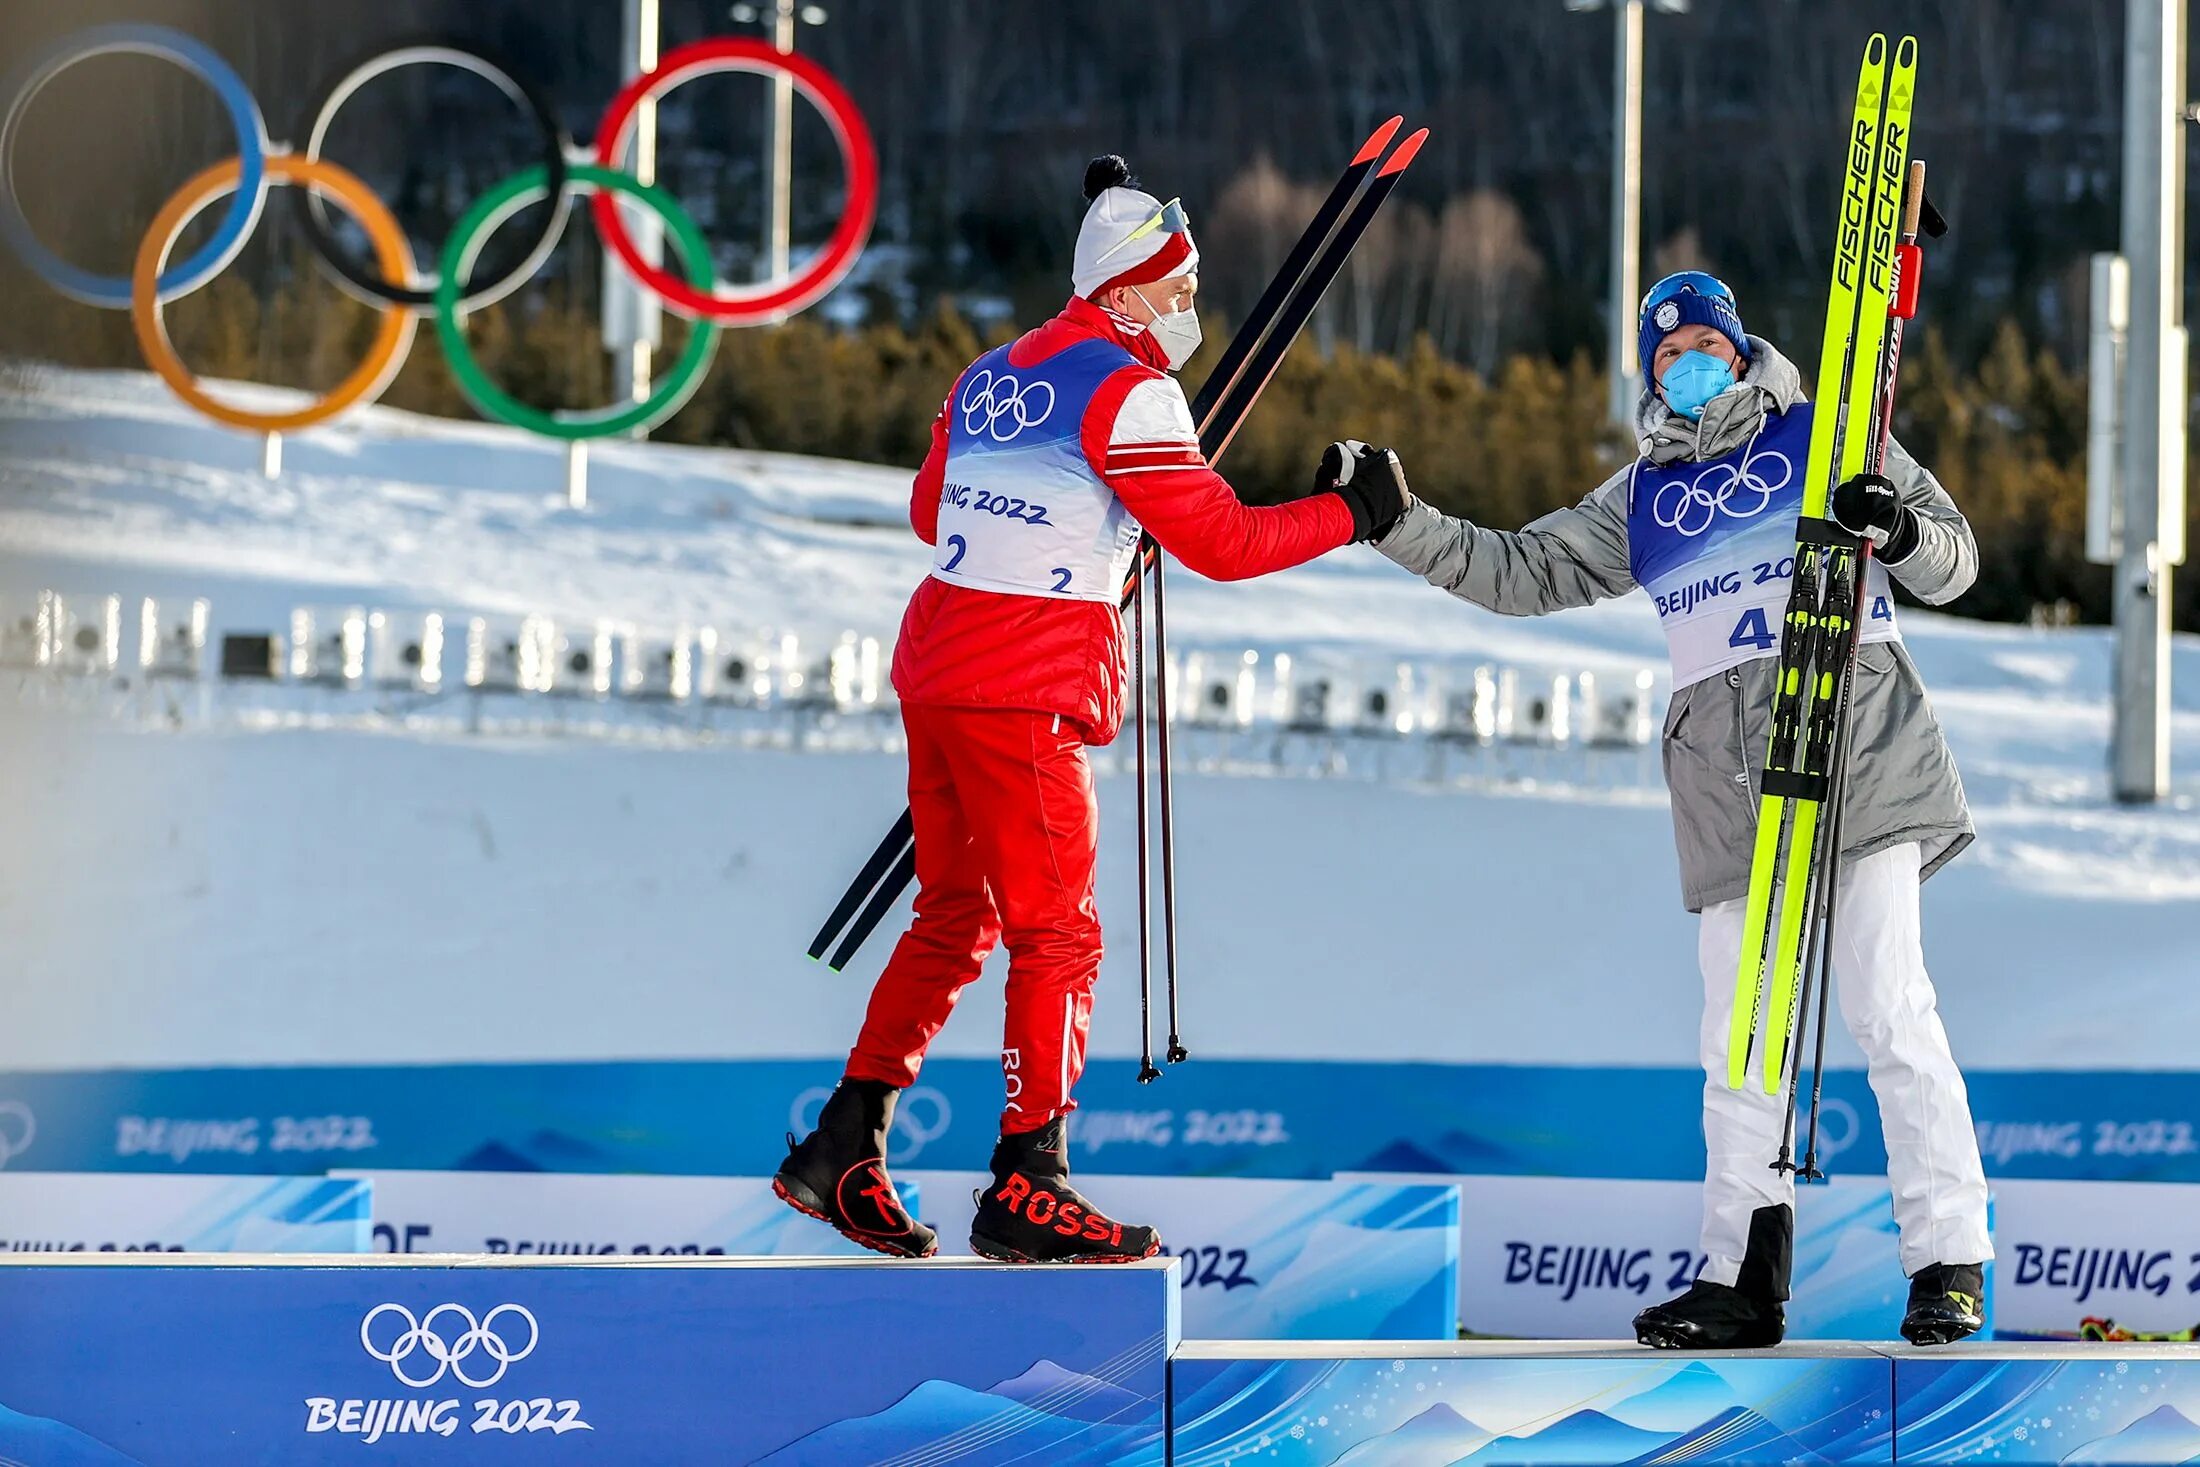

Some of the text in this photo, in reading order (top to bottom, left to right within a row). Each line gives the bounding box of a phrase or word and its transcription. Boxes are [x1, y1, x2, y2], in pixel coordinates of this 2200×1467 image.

[1837, 119, 1873, 292] FISCHER
[1870, 122, 1905, 295] FISCHER
[940, 483, 1055, 528] JING 2022
[940, 534, 967, 575] 2
[1050, 567, 1073, 594] 2
[1655, 571, 1741, 618] BEIJING
[1728, 607, 1777, 650] 4
[1871, 596, 1892, 622] 4
[116, 1115, 378, 1163] BEIJING 2022
[1183, 1109, 1290, 1146] 2022
[1975, 1119, 2199, 1166] EIJING 2022
[996, 1172, 1123, 1248] ROSSI
[1160, 1244, 1259, 1292] 022
[1504, 1241, 1652, 1303] BEIJING
[2013, 1243, 2172, 1304] BEIJING
[304, 1397, 595, 1444] BEIJING 2022
